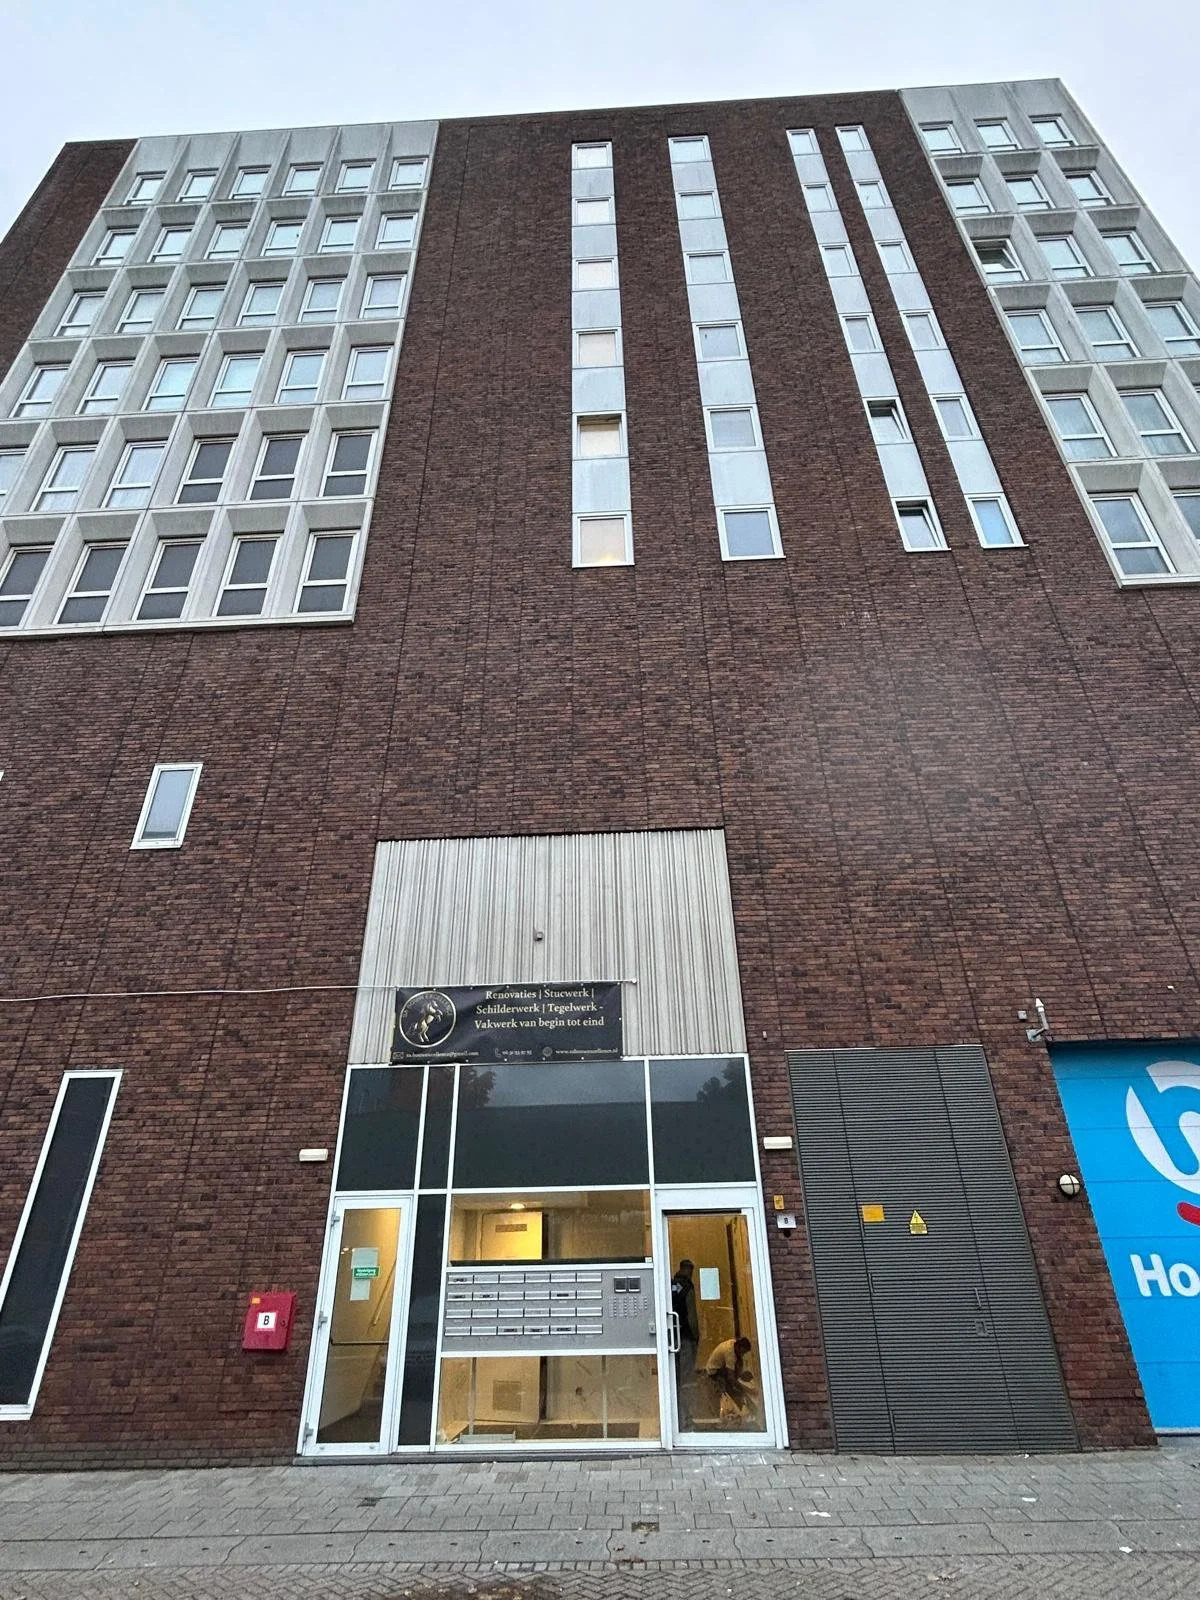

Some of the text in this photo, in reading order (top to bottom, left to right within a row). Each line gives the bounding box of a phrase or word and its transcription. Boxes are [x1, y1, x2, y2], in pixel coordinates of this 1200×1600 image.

[485, 990, 537, 1000] Renovaties
[544, 988, 589, 998] Stucwerk
[476, 1003, 540, 1015] Schilderwerk
[547, 1002, 598, 1015] Tegelwerk
[474, 1016, 605, 1029] Vakwerk van begin tot eind
[263, 1315, 270, 1326] B
